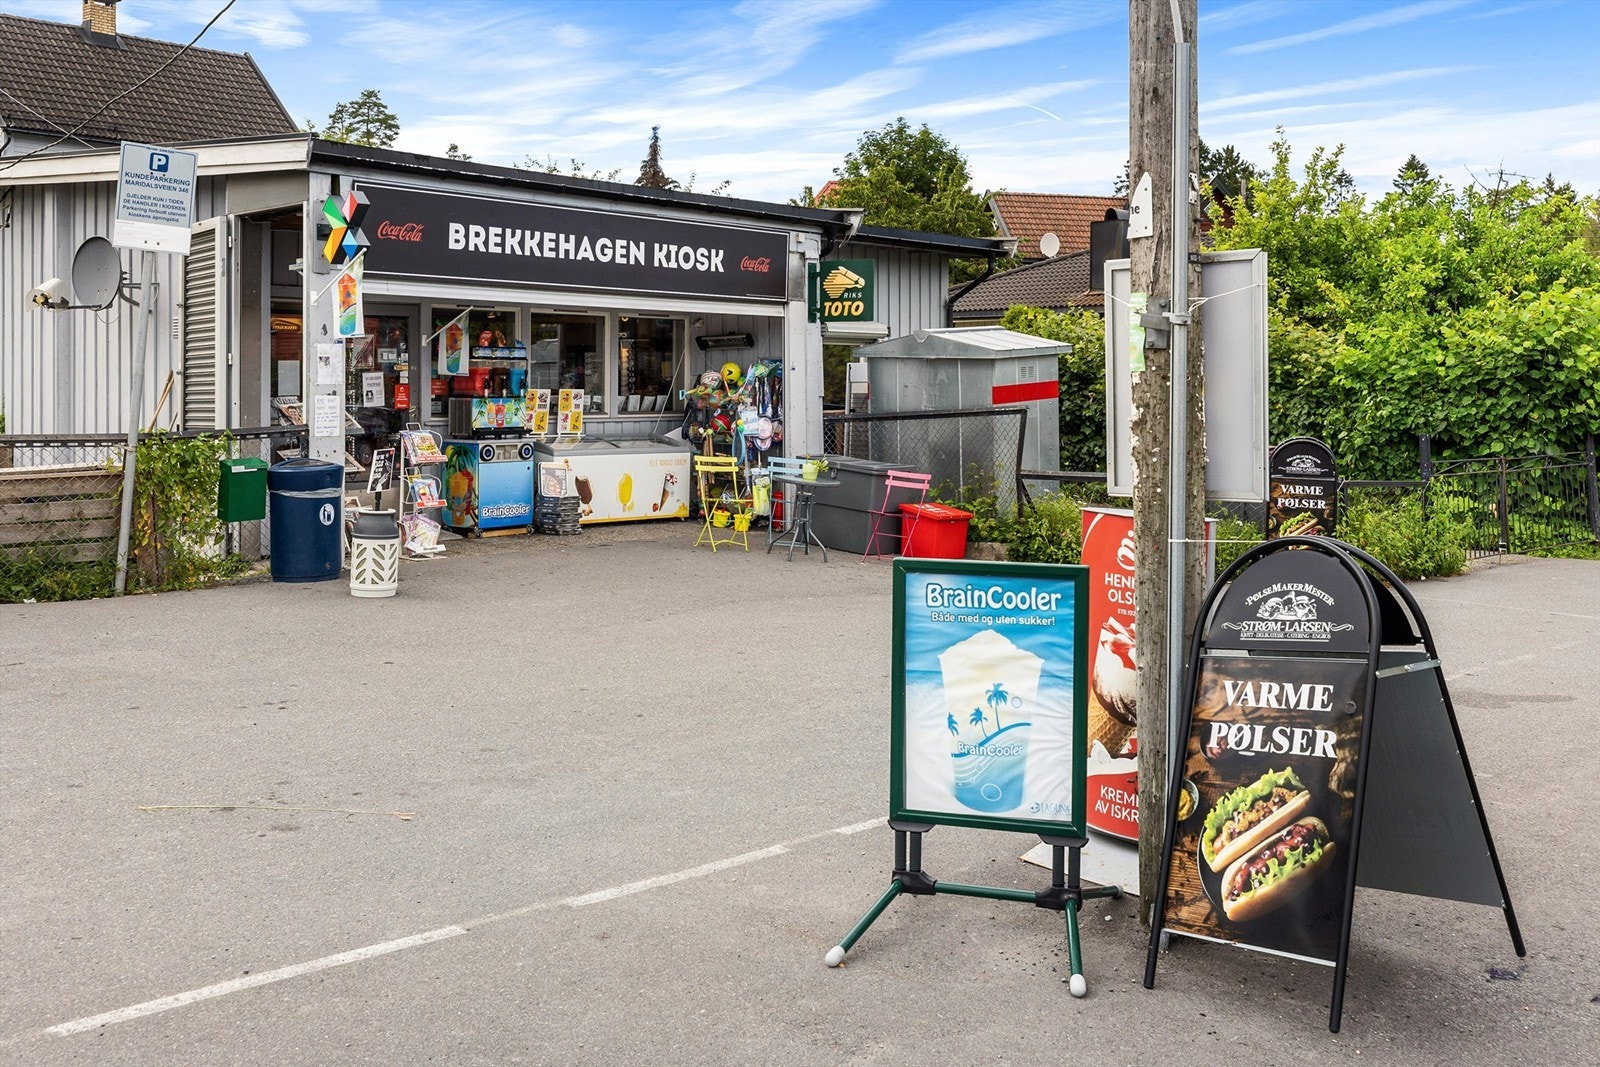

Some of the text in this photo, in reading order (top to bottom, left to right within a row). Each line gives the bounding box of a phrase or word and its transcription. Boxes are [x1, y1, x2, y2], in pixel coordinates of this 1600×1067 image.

[125, 171, 191, 187] KUNDEPARKERING
[125, 179, 177, 192] MARIDALSVEIEN
[126, 192, 152, 201] GJELDER
[132, 200, 158, 208] HANDLER
[123, 205, 147, 213] Parkering
[148, 208, 167, 216] forbudt
[128, 211, 152, 219] kioskens
[377, 220, 424, 242] Coca-Cola
[448, 222, 725, 273] BREKKEHAGEN KIOSK
[740, 255, 771, 273] Coca-Cola
[823, 301, 865, 317] TOTO
[1280, 484, 1324, 496] VARME
[481, 503, 531, 518] BrainCooler
[1277, 497, 1326, 509] PØLSER
[926, 583, 1062, 611] BrainCooler
[931, 611, 1055, 626] Både med og uten sukker!
[1241, 621, 1331, 632] STRØM-LARSEN
[1222, 680, 1334, 712] VARME
[1207, 722, 1338, 759] PØLSER
[957, 741, 1024, 757] BrainCooler
[1094, 799, 1140, 824] AV ISKR
